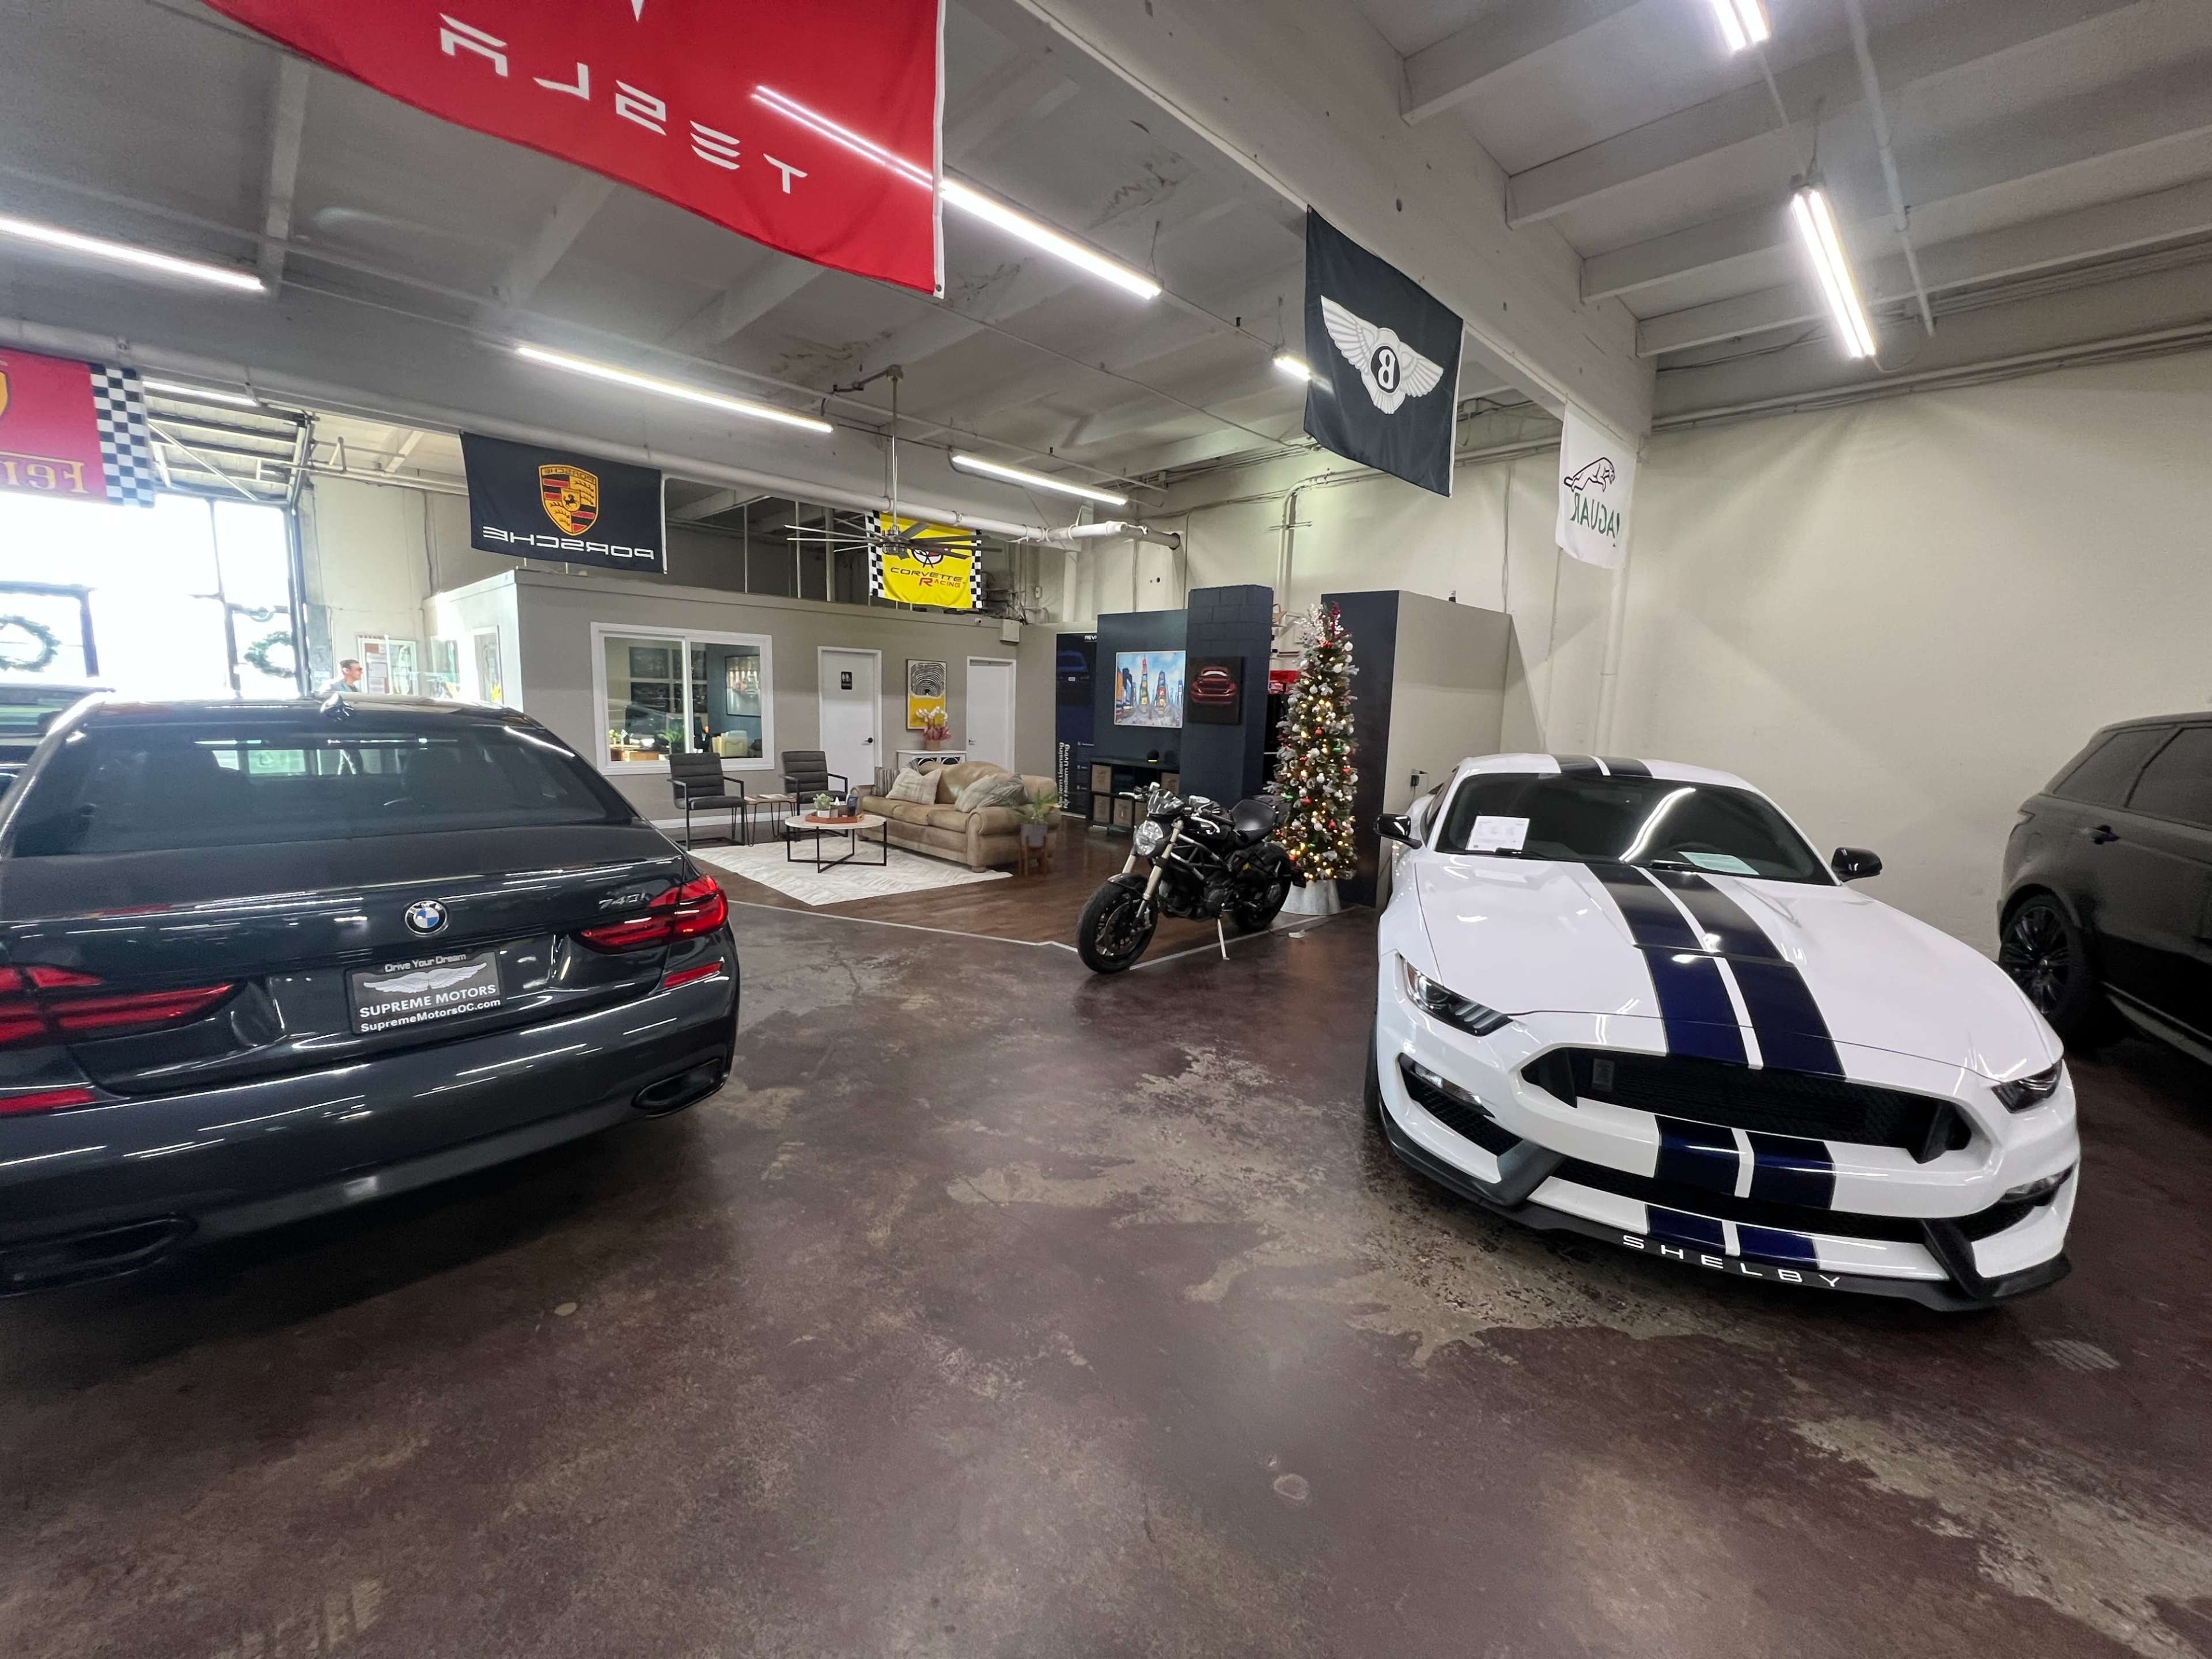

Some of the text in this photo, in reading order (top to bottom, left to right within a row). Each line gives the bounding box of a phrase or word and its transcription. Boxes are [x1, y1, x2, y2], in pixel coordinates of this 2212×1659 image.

[890, 567, 963, 582] CORVETTE
[919, 577, 961, 588] RACING
[385, 953, 467, 972] Drive Your Dream
[359, 984, 497, 1018] SUPREME MOTORS
[361, 999, 501, 1032] SupremeMotorsOC.com
[1623, 1234, 1840, 1287] SHELBY
